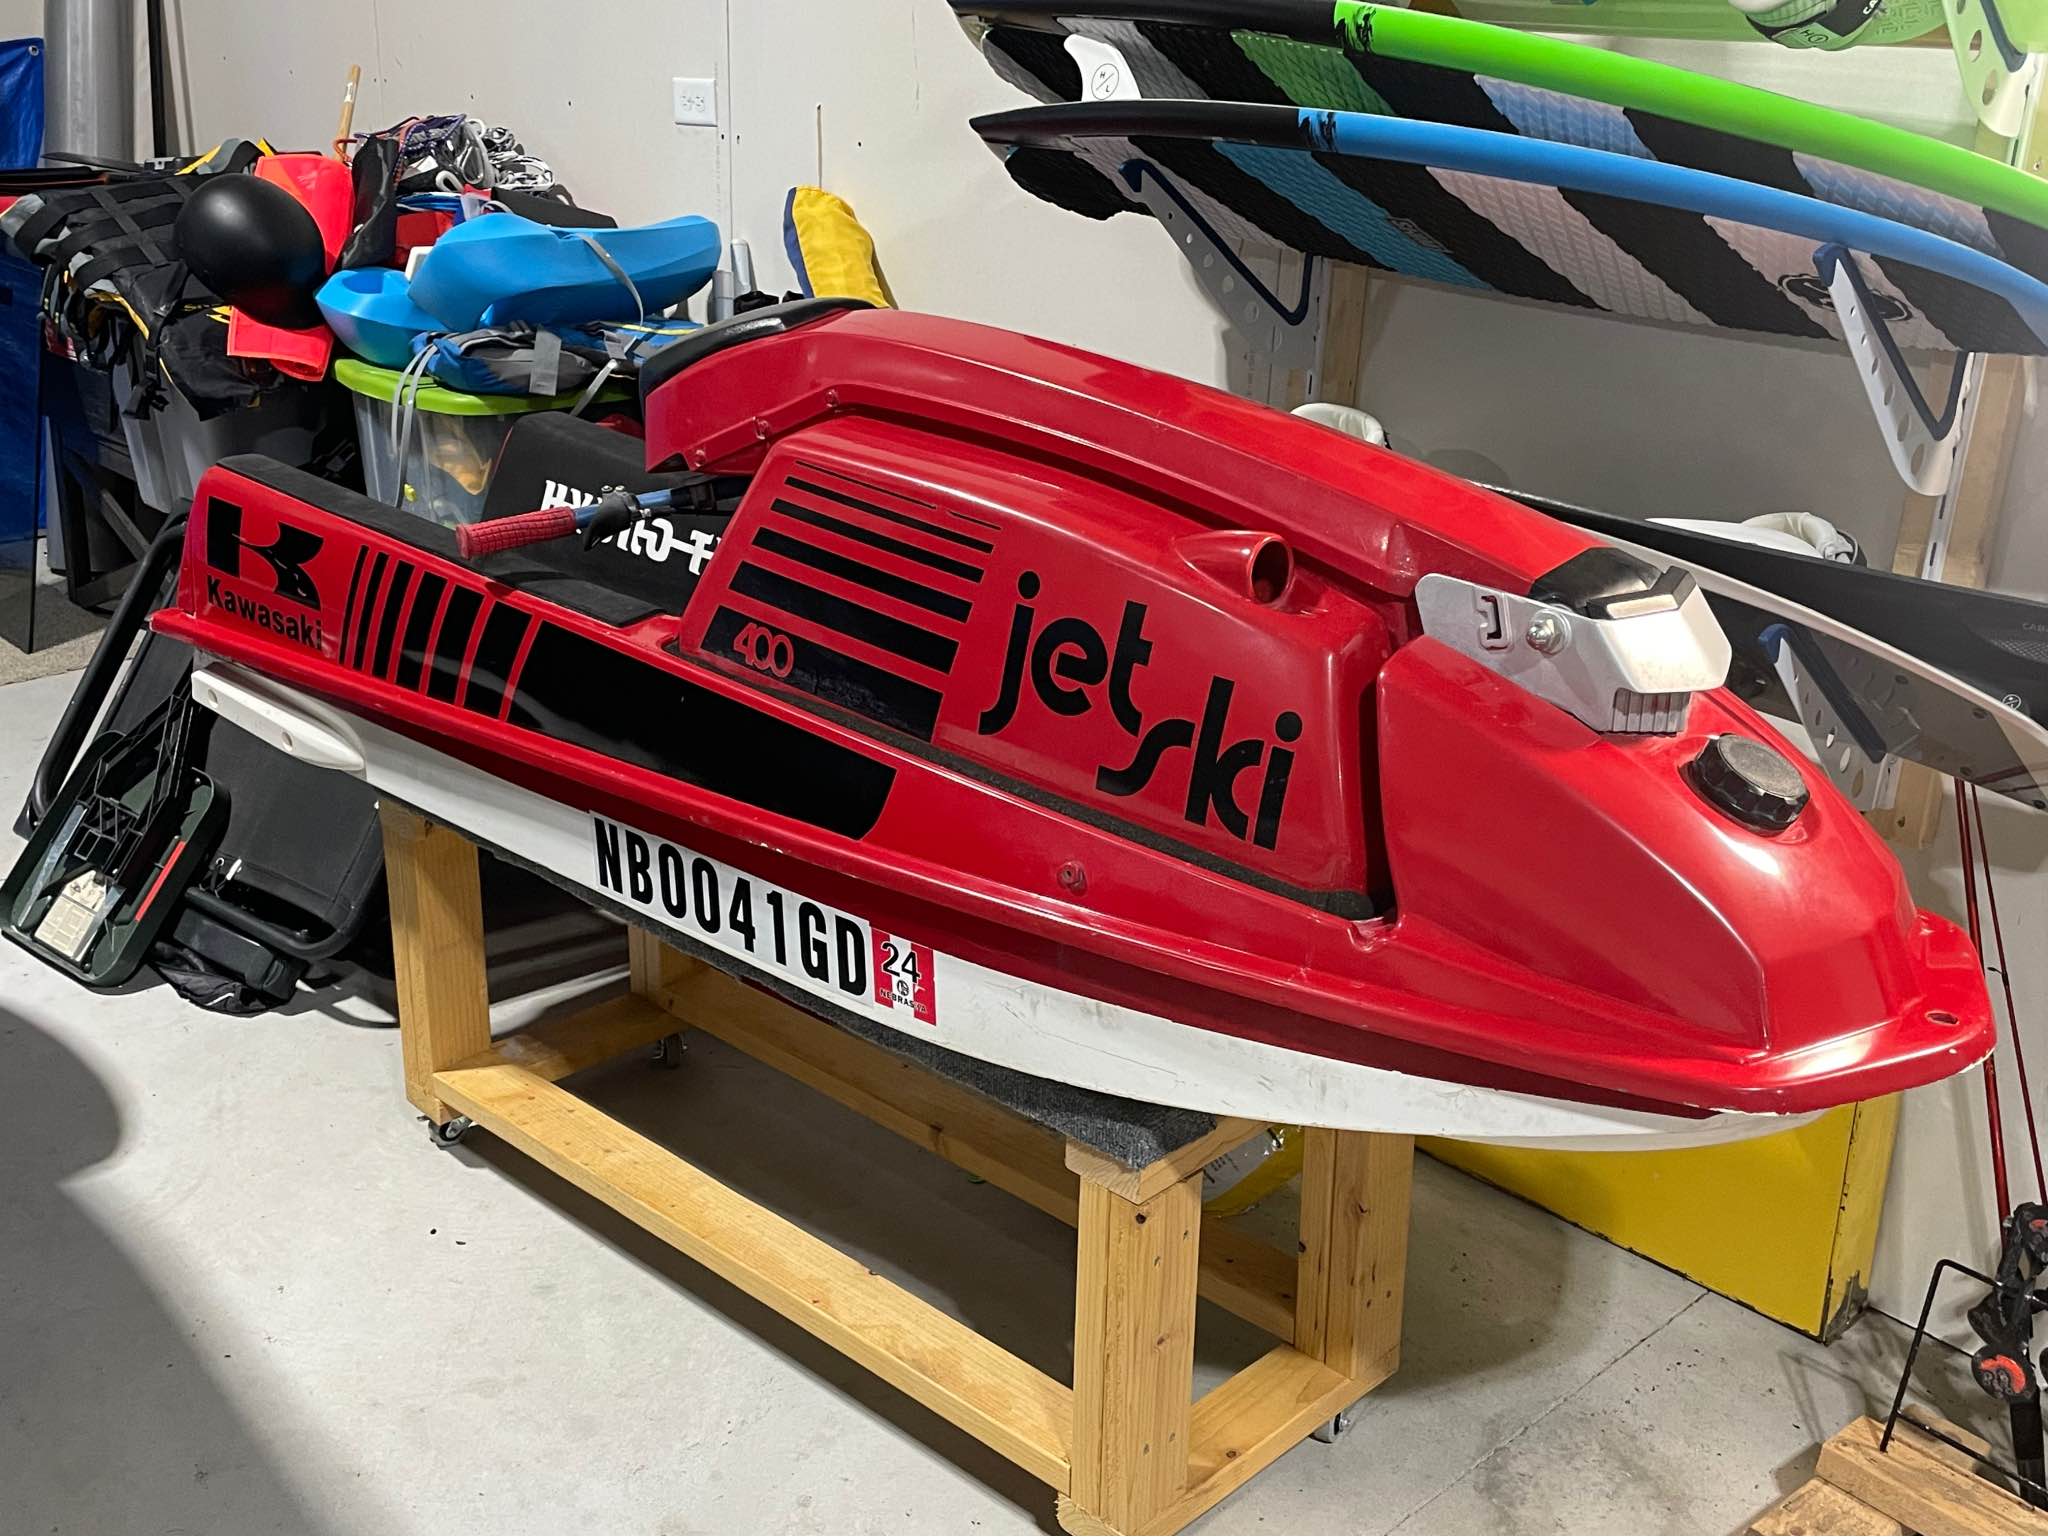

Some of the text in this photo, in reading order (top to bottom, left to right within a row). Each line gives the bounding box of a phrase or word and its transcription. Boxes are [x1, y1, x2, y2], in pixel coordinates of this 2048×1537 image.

[207, 574, 323, 651] Kawasaki
[733, 622, 794, 678] 400
[978, 570, 1154, 739] jet
[1095, 673, 1304, 851] ski
[594, 817, 868, 996] NB0041GD
[881, 942, 922, 984] 24
